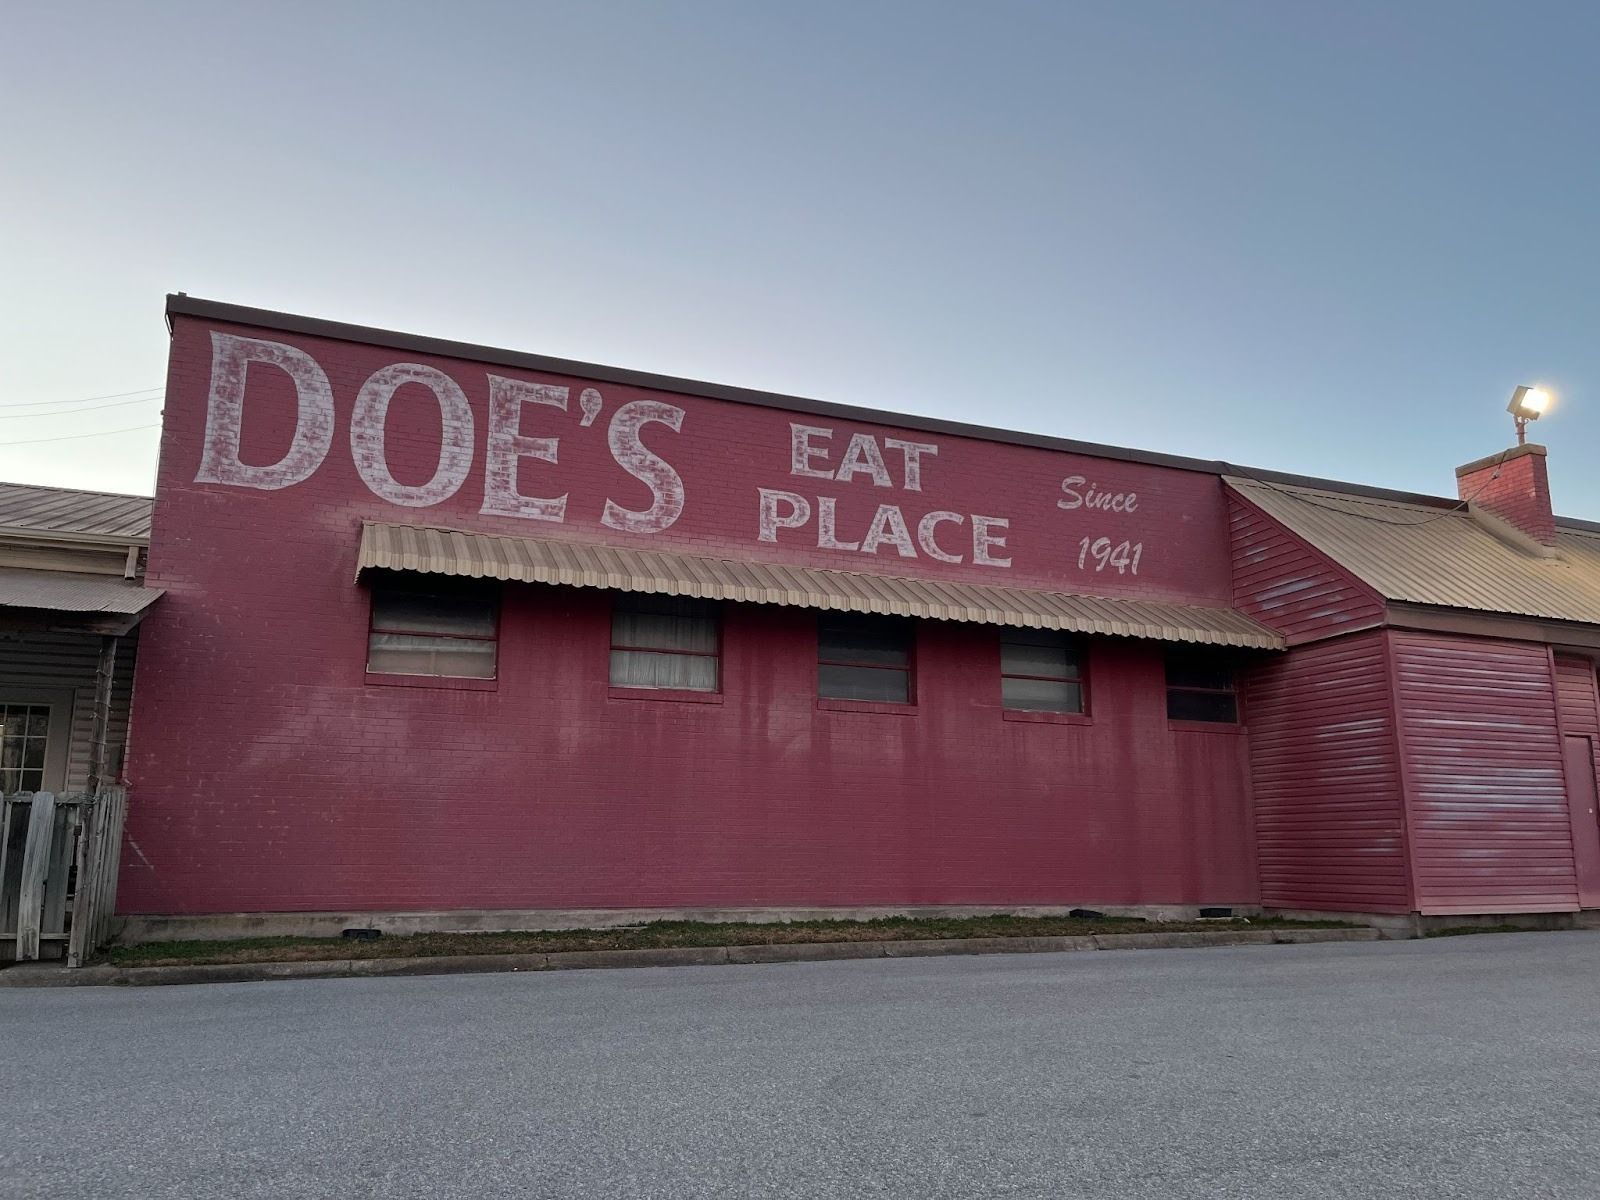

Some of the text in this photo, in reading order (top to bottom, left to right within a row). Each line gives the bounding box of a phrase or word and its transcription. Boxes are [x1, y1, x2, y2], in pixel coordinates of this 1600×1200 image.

[193, 330, 686, 533] DOE'S
[789, 422, 938, 492] EAT
[757, 487, 1012, 568] PLACE
[1057, 475, 1139, 512] Since
[1078, 536, 1143, 575] 1941
